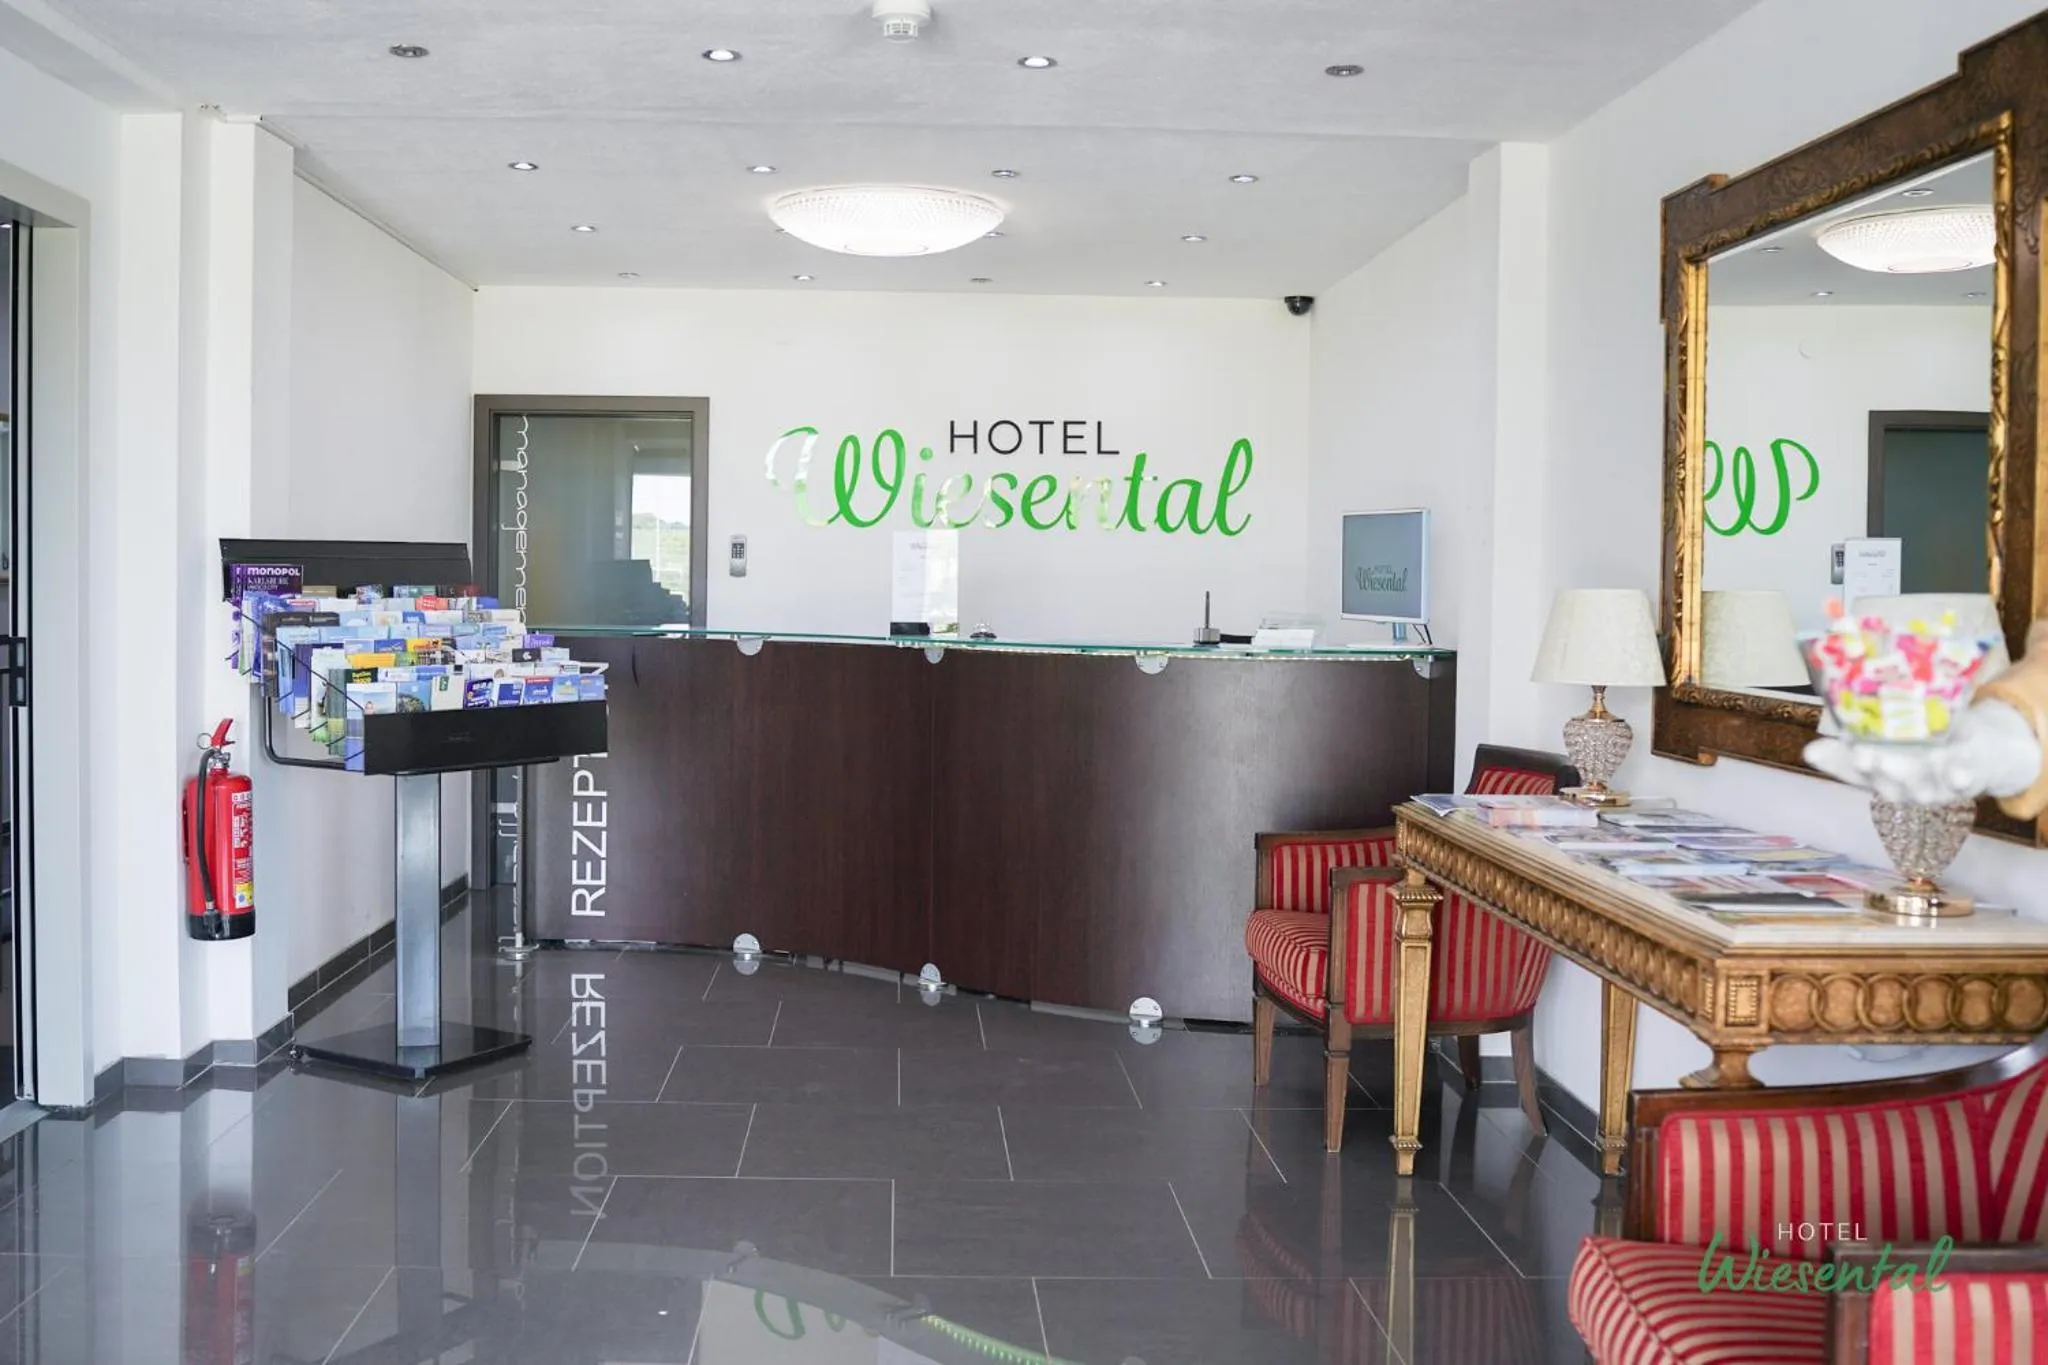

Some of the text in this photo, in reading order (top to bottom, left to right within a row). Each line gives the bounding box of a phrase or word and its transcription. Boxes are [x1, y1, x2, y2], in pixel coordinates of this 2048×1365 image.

[949, 420, 1120, 455] HOTEL
[764, 426, 1253, 536] Wiesental
[501, 415, 529, 624] managemen
[1354, 566, 1409, 592] Wiesental
